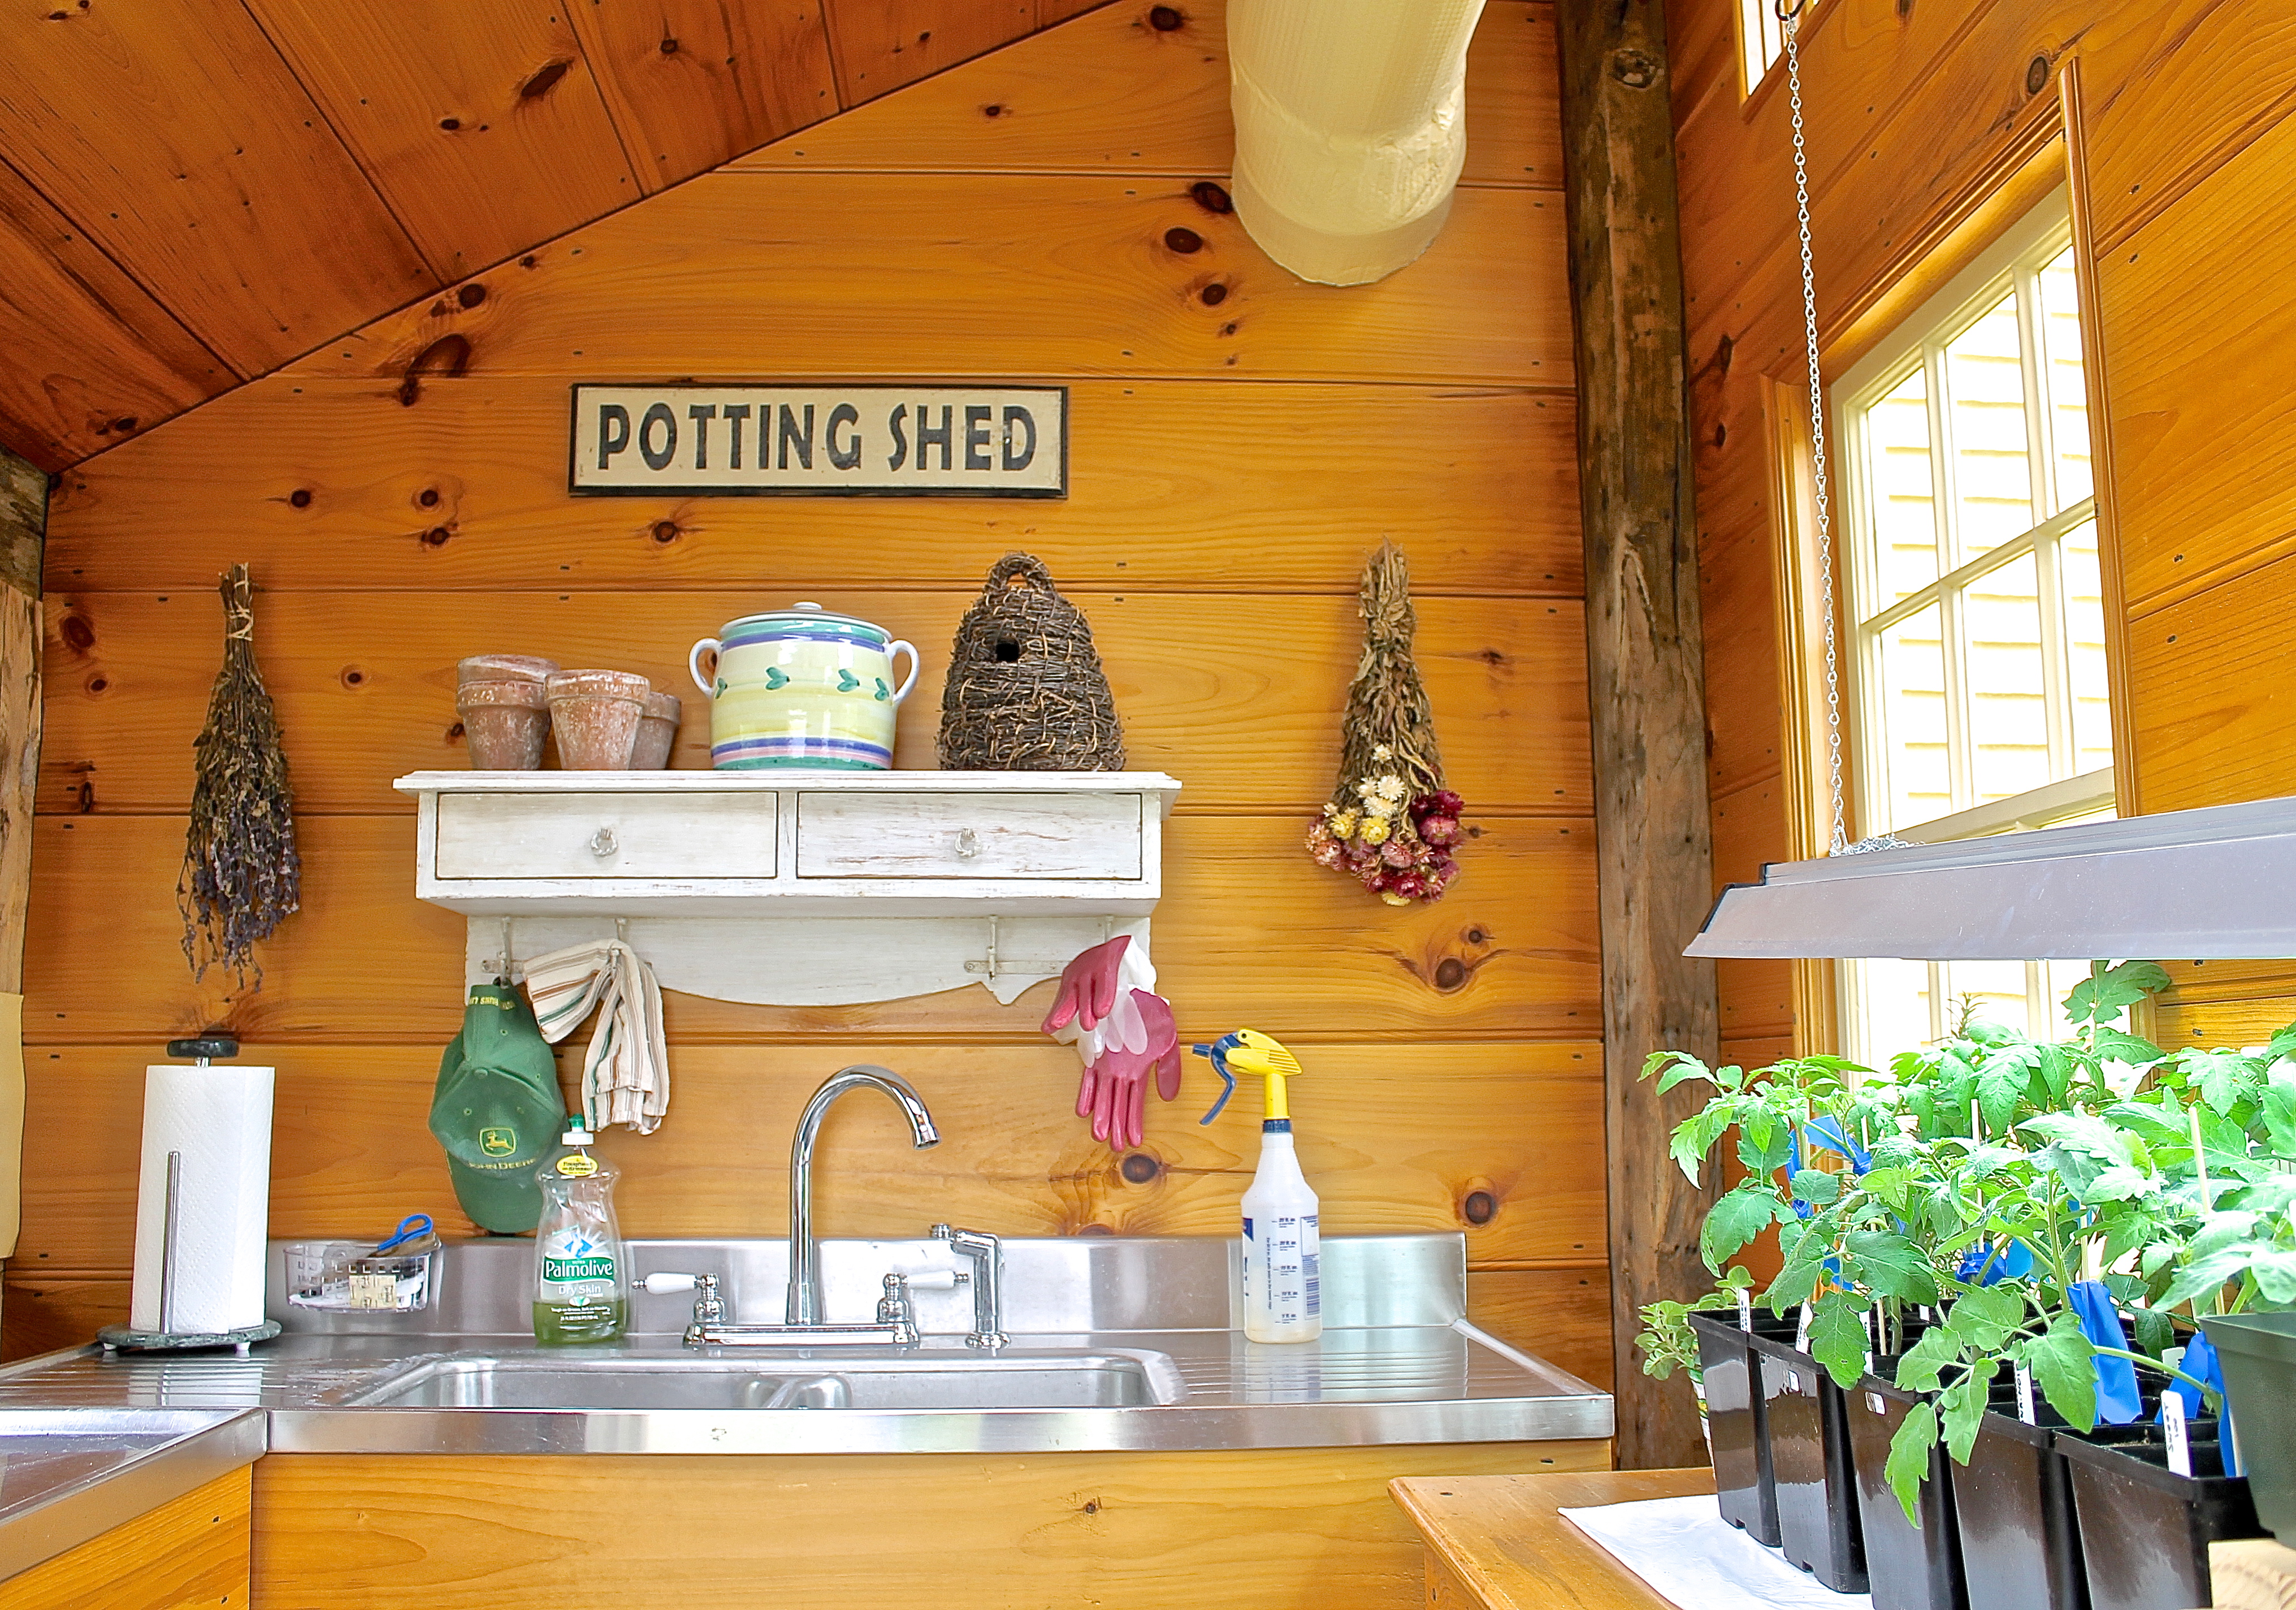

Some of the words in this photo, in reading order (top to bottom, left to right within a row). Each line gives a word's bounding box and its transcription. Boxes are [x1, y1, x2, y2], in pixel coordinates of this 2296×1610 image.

[597, 402, 862, 471] POTTING
[887, 402, 1037, 471] SHED
[545, 1260, 613, 1278] Palmolive
[558, 1286, 577, 1296] Dry
[578, 1284, 601, 1295] Skin
